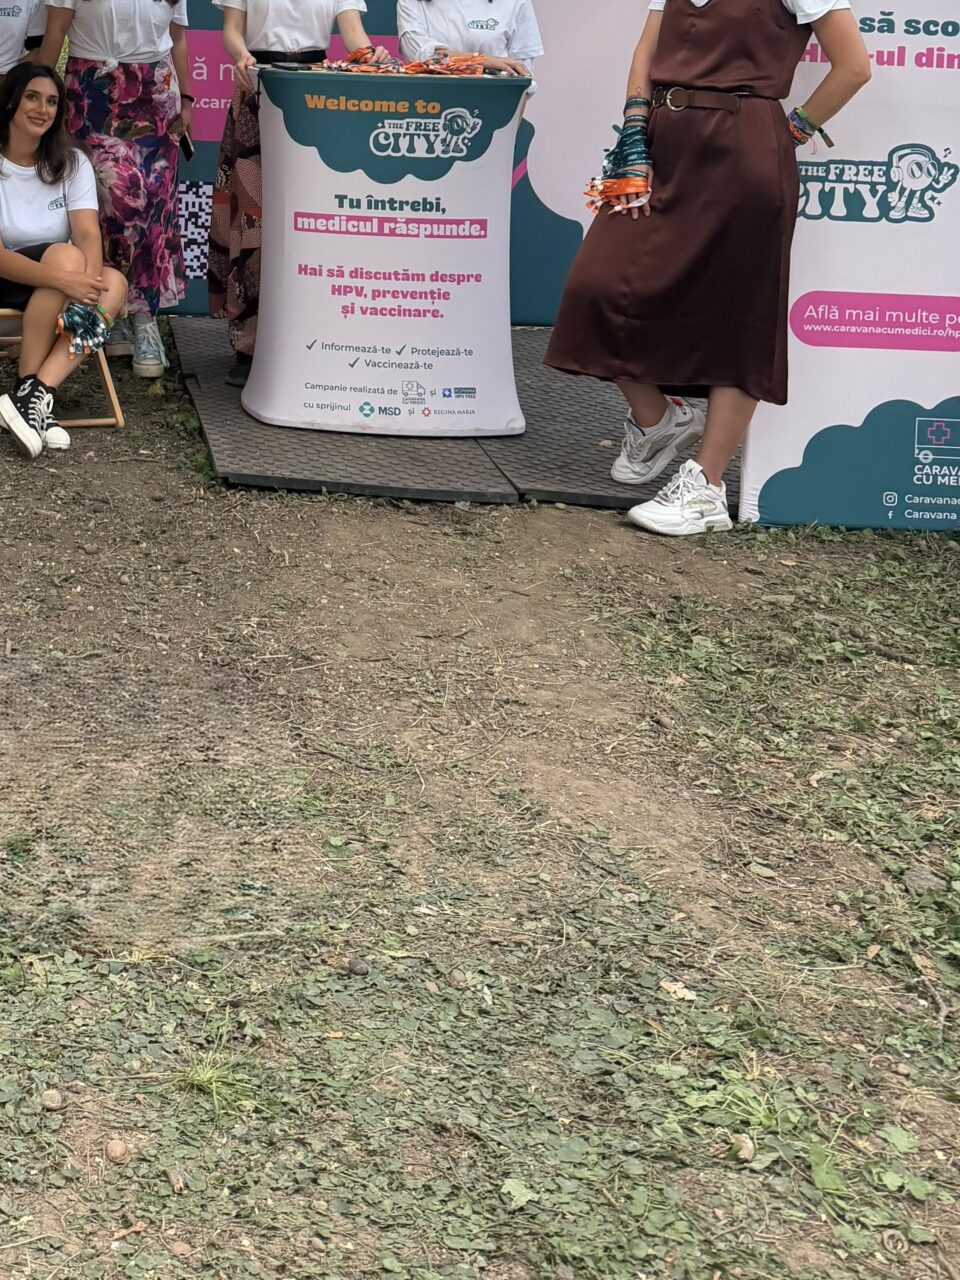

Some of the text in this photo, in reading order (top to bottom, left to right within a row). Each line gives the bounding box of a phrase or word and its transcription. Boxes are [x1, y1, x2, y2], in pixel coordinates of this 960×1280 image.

[858, 11, 960, 37] să sco
[305, 94, 441, 114] Welcome to
[387, 121, 440, 133] THE FREE
[371, 132, 440, 154] CITY
[799, 164, 887, 183] THE FREE
[334, 194, 446, 215] Tu întrebi,
[296, 215, 486, 239] medicul răspunde.
[297, 264, 482, 287] Hai să discutăm despre
[331, 284, 451, 305] HPV, prevenție
[341, 302, 444, 319] și vaccinare.
[803, 304, 839, 321] Află
[845, 307, 880, 322] mai
[885, 308, 940, 324] multe
[803, 322, 960, 339] www.caravanacumedici.ro/hp
[321, 341, 474, 359] Informează-te Protejează-te
[364, 358, 434, 371] Vaccinează-te
[304, 381, 348, 395] Campanie
[349, 385, 386, 396] realizată
[387, 387, 398, 396] de
[303, 400, 352, 412] cu sprijinul
[378, 406, 401, 417] MSD
[408, 407, 415, 417] și
[914, 465, 960, 476] CARAV
[913, 475, 960, 486] CU ME
[904, 509, 957, 520] Caravana
